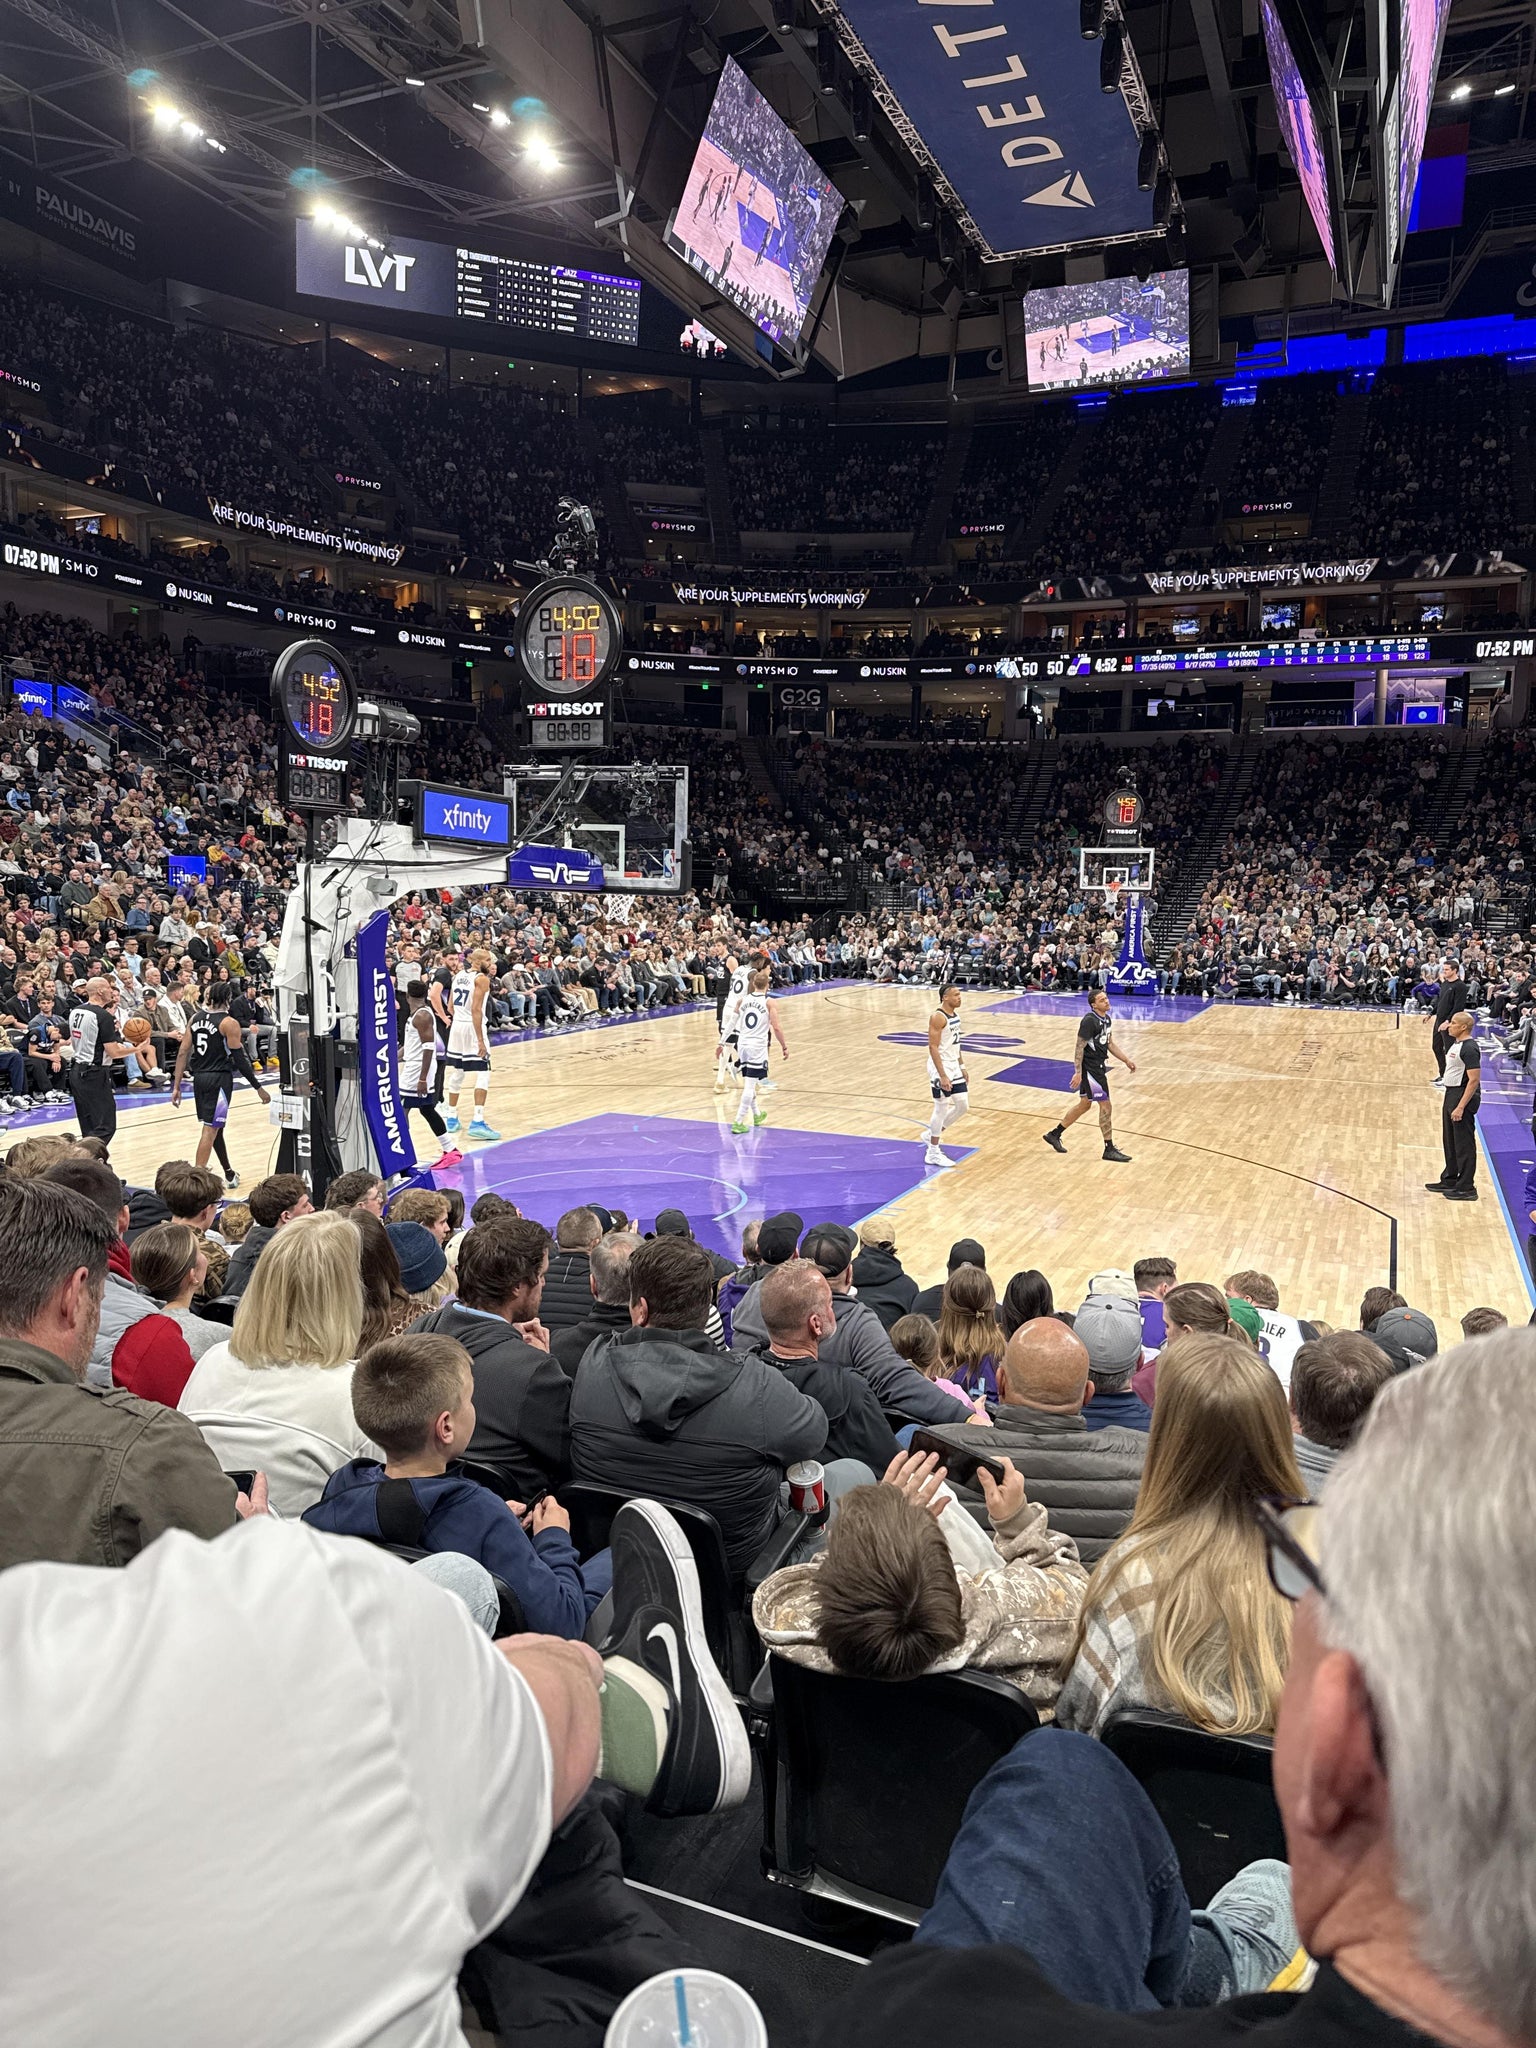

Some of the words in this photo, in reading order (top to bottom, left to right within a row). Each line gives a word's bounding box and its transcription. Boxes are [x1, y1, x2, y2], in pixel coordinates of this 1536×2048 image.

[918, 0, 1064, 168] DELT
[9, 180, 21, 196] BY
[345, 246, 415, 292] LVT
[1151, 369, 1164, 377] UTA
[345, 476, 372, 488] PRYSM
[1252, 502, 1282, 512] PRYSM
[212, 503, 234, 522] ARE
[235, 510, 265, 530] YOUR
[266, 519, 342, 549] SUPPLEMENTS
[343, 538, 401, 561] WORKING?
[660, 522, 687, 532] PRYSM
[969, 525, 996, 533] PRYSM
[4, 544, 39, 570] 07:52
[40, 554, 60, 575] PM
[1150, 576, 1174, 589] ARE
[1175, 573, 1210, 587] YOUR
[1211, 567, 1300, 586] SUPPLEMENTS
[1302, 563, 1371, 579] WORKING?
[178, 587, 193, 600] NU
[677, 587, 698, 600] ARE
[699, 588, 730, 602] YOUR
[731, 590, 808, 604] SUPPLEMENTS
[809, 593, 866, 605] WORKING?
[287, 612, 323, 628] PRYSM
[553, 605, 600, 631] 4:52
[411, 634, 425, 645] NU
[1476, 641, 1509, 657] 07:52
[1513, 639, 1534, 656] PM
[641, 660, 655, 670] NU
[749, 665, 785, 675] PRYSM
[872, 667, 886, 676] NU
[1021, 661, 1039, 677] 50
[1046, 660, 1064, 676] 50
[1094, 657, 1118, 673] 4:52
[303, 673, 341, 702] 4:52
[18, 692, 47, 706] xfinity
[780, 688, 821, 706] G2G
[548, 702, 604, 716] TISSOT
[309, 701, 333, 736] 18
[306, 757, 348, 772] TISSOT
[1117, 797, 1137, 807] 4:52
[443, 803, 491, 834] xfinity
[1119, 806, 1134, 823] 18
[1128, 929, 1136, 959] AMERICA
[372, 968, 388, 1040] FIRST
[454, 988, 470, 1007] 27
[73, 1012, 85, 1029] 31
[745, 1012, 758, 1029] 0
[196, 1033, 208, 1056] 5
[374, 1044, 405, 1155] AMERICA
